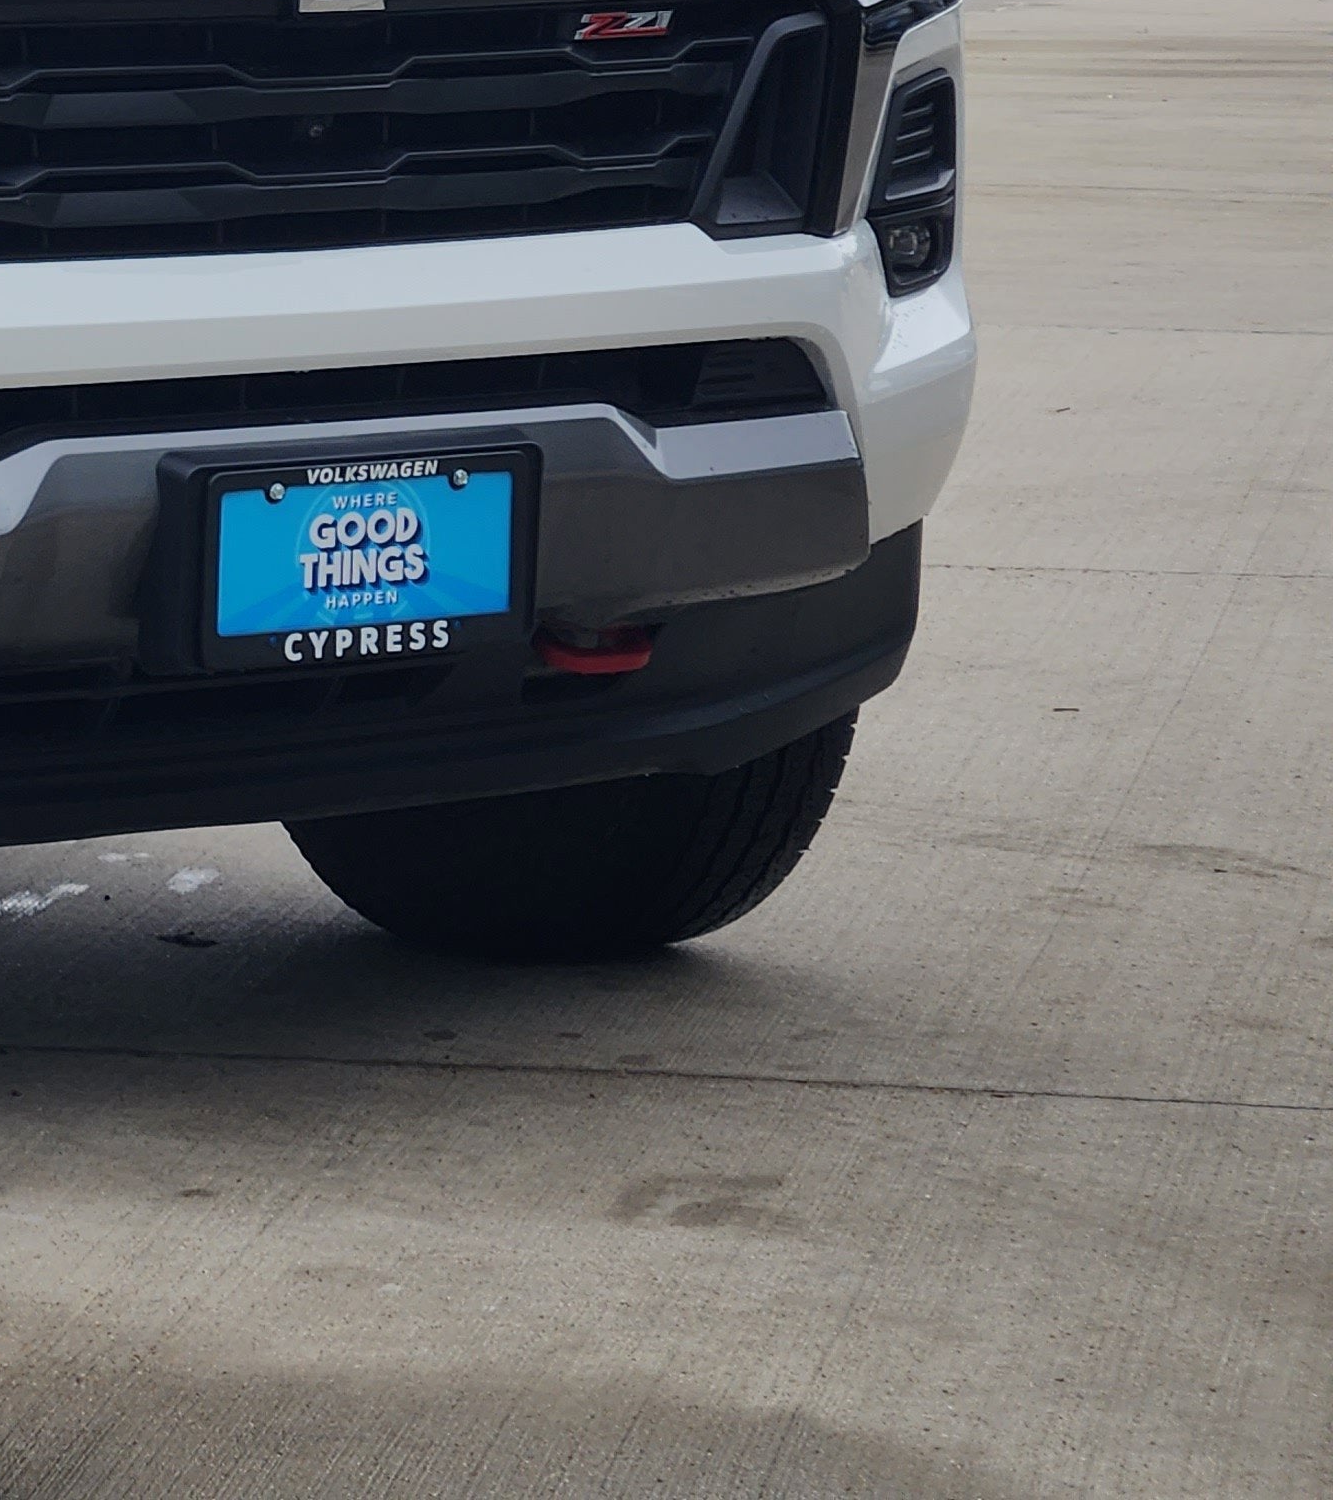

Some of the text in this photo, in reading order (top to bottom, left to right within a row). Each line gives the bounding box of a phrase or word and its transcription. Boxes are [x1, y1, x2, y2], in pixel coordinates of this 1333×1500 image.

[306, 460, 438, 485] VOLKSWAGEN
[333, 492, 398, 510] WHERE
[309, 508, 419, 550] GOOD
[299, 543, 426, 590] THINGS
[325, 590, 399, 610] HAPPEN
[284, 620, 450, 663] CYPRESS
